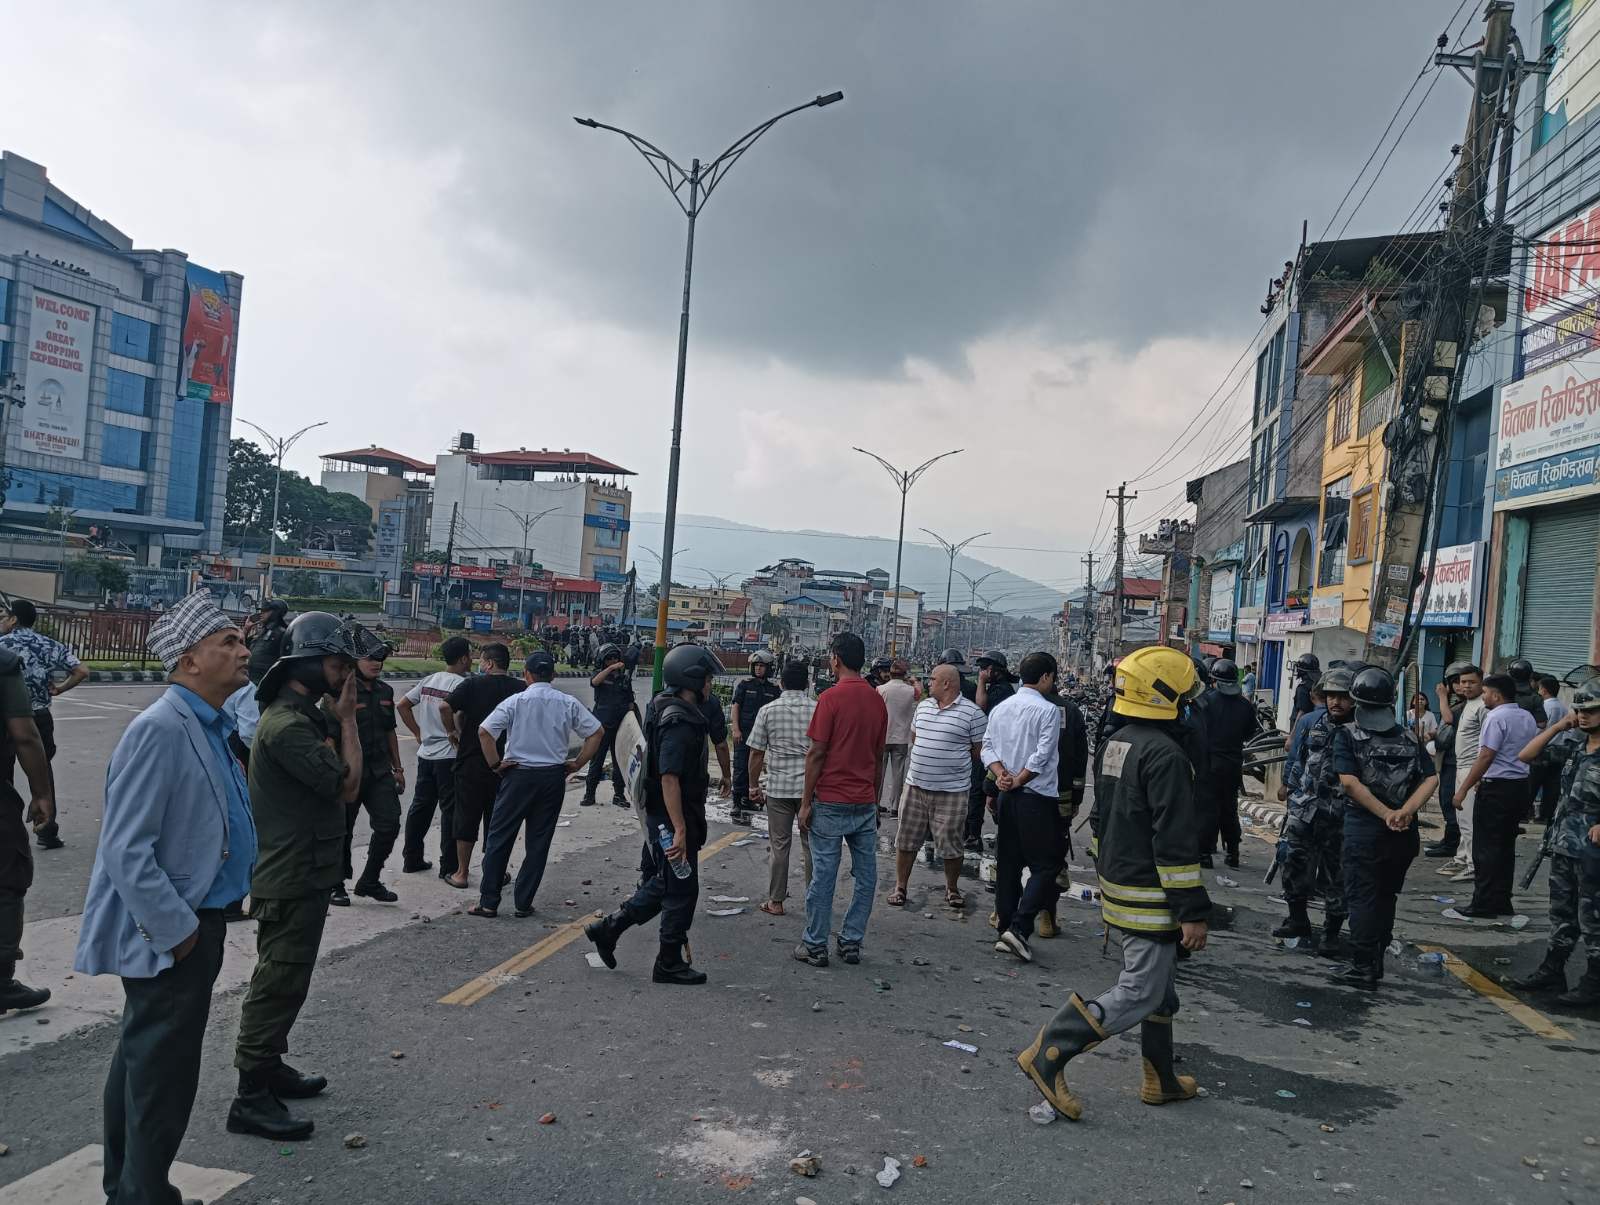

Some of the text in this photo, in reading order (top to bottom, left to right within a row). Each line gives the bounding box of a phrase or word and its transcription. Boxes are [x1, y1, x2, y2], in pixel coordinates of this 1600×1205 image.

[35, 295, 90, 322] WELCOME
[56, 319, 68, 331] TO
[46, 330, 75, 346] GREAT
[35, 340, 80, 359] SHOPPING
[30, 350, 83, 373] EXPERIENCE
[1501, 376, 1600, 440] चितवन रिकण्डिस
[24, 429, 80, 447] BHAT-BHATENI
[1510, 469, 1539, 491] चितवन
